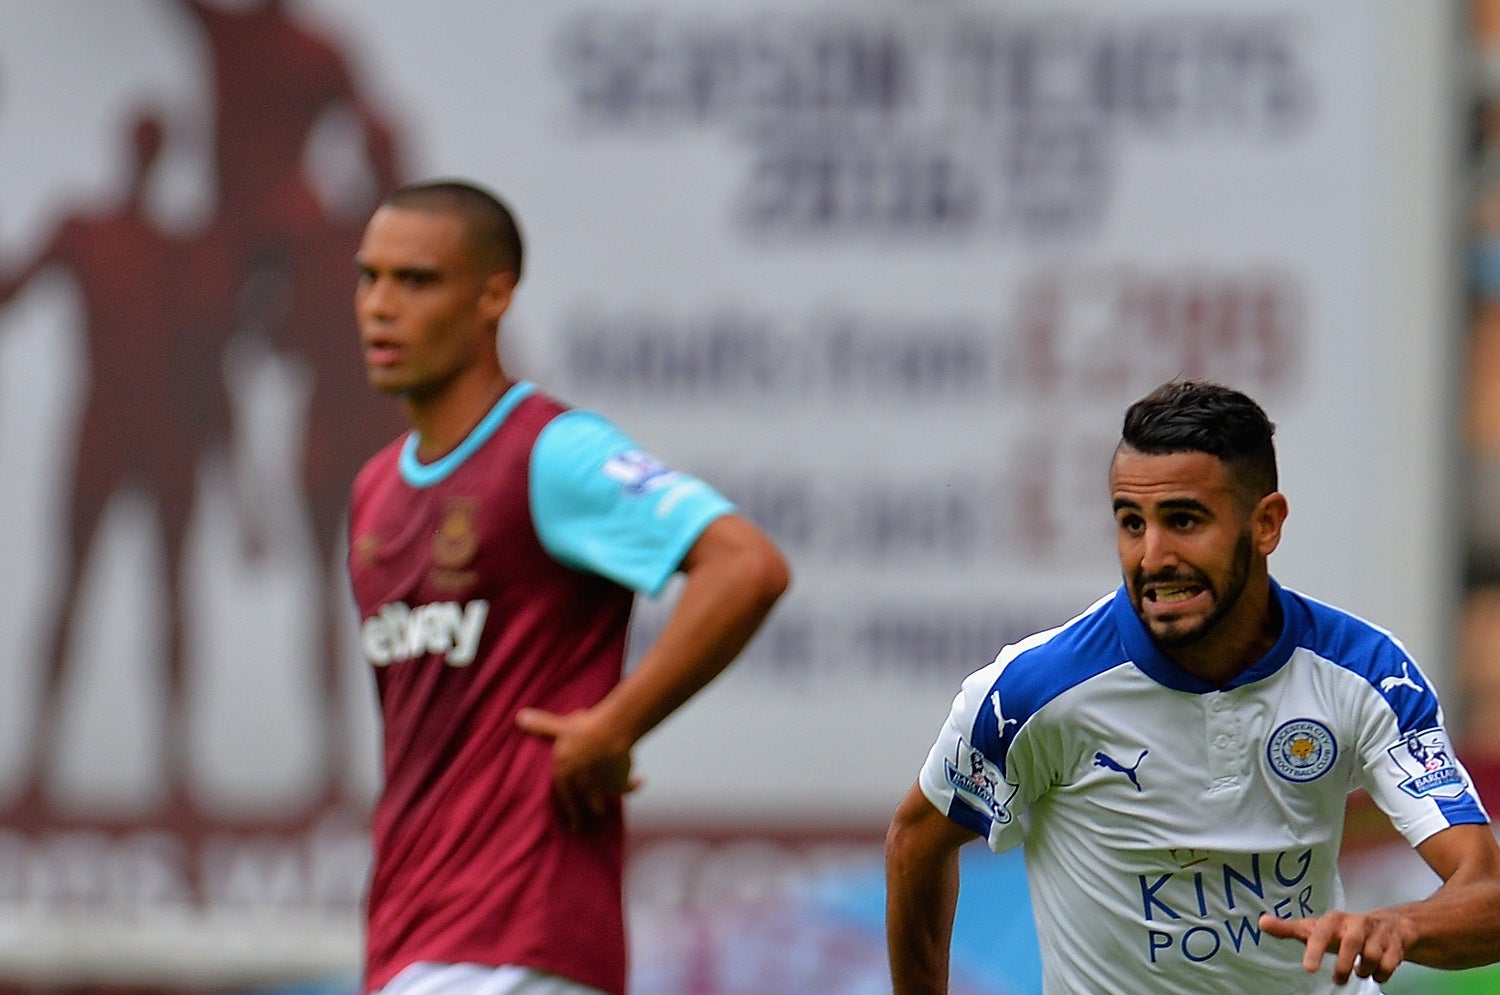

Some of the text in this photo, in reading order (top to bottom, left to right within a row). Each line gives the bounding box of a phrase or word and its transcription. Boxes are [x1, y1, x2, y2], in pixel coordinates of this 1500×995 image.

[1273, 723, 1331, 752] LEICESTER CITY
[1274, 748, 1332, 777] FOOTBALL CLUB
[1138, 849, 1312, 921] KING
[1149, 885, 1314, 963] POWER
